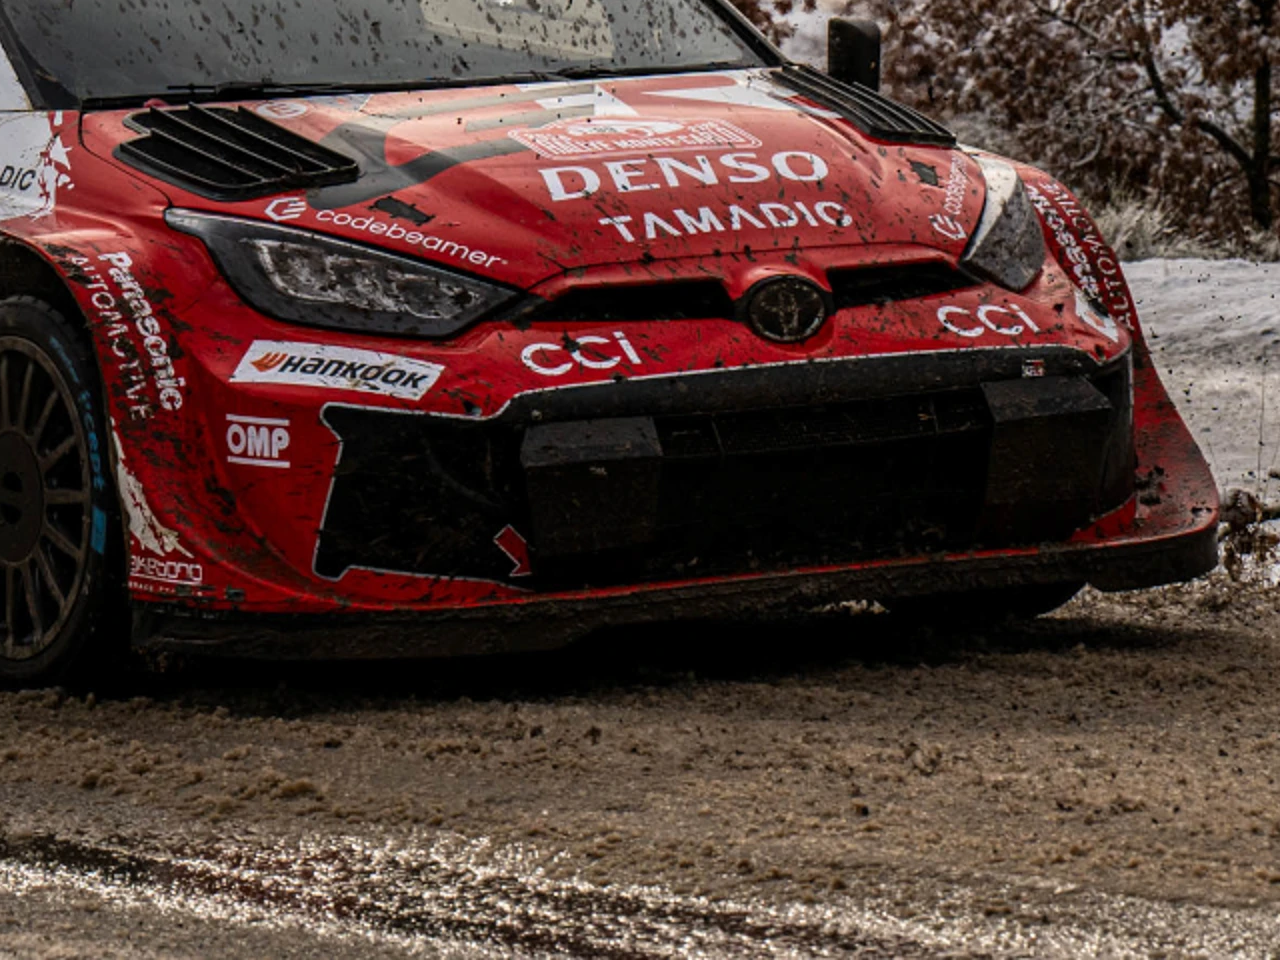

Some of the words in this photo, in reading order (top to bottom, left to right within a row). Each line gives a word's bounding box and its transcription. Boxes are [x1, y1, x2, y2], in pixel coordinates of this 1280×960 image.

[538, 150, 830, 203] DENSO
[315, 208, 495, 268] codebeamer
[599, 200, 854, 244] TAMADIC
[97, 251, 187, 411] Panasonic
[225, 423, 291, 460] OMP
